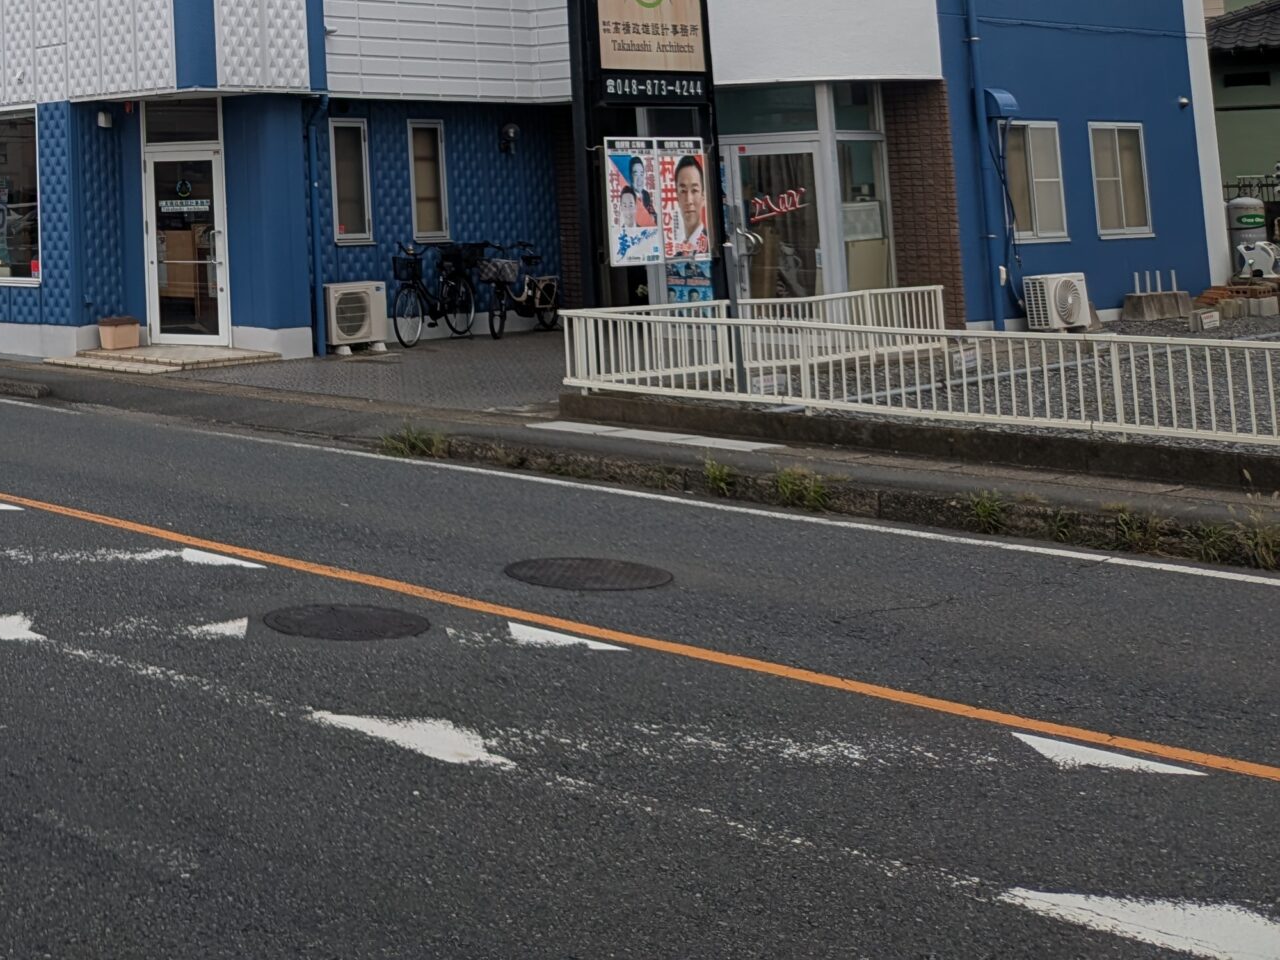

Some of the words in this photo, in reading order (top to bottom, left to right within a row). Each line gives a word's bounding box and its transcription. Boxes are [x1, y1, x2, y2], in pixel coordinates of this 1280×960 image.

[611, 40, 652, 53] Takahashi
[656, 41, 695, 54] Architects
[616, 79, 703, 96] 048-873-4244
